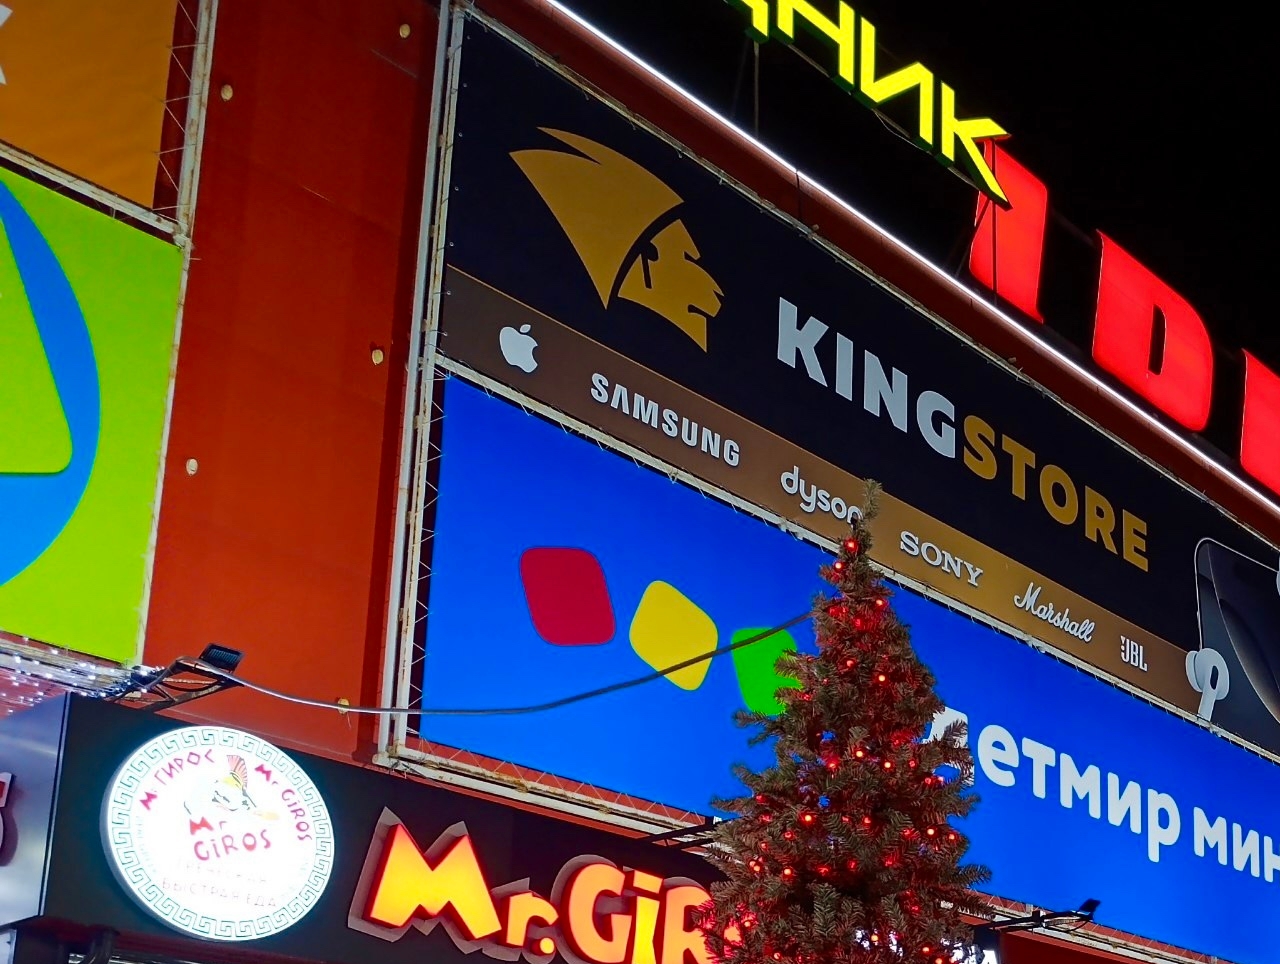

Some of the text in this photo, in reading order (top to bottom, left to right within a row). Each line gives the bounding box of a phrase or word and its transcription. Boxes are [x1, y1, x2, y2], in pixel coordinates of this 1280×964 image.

[742, 0, 1008, 202] НИК
[590, 373, 740, 467] SAMSUNG
[778, 297, 1149, 571] KINGSTORE
[780, 466, 863, 526] dyson
[900, 530, 983, 587] SONY
[1014, 582, 1095, 642] Marshall
[1120, 636, 1148, 672] JBL
